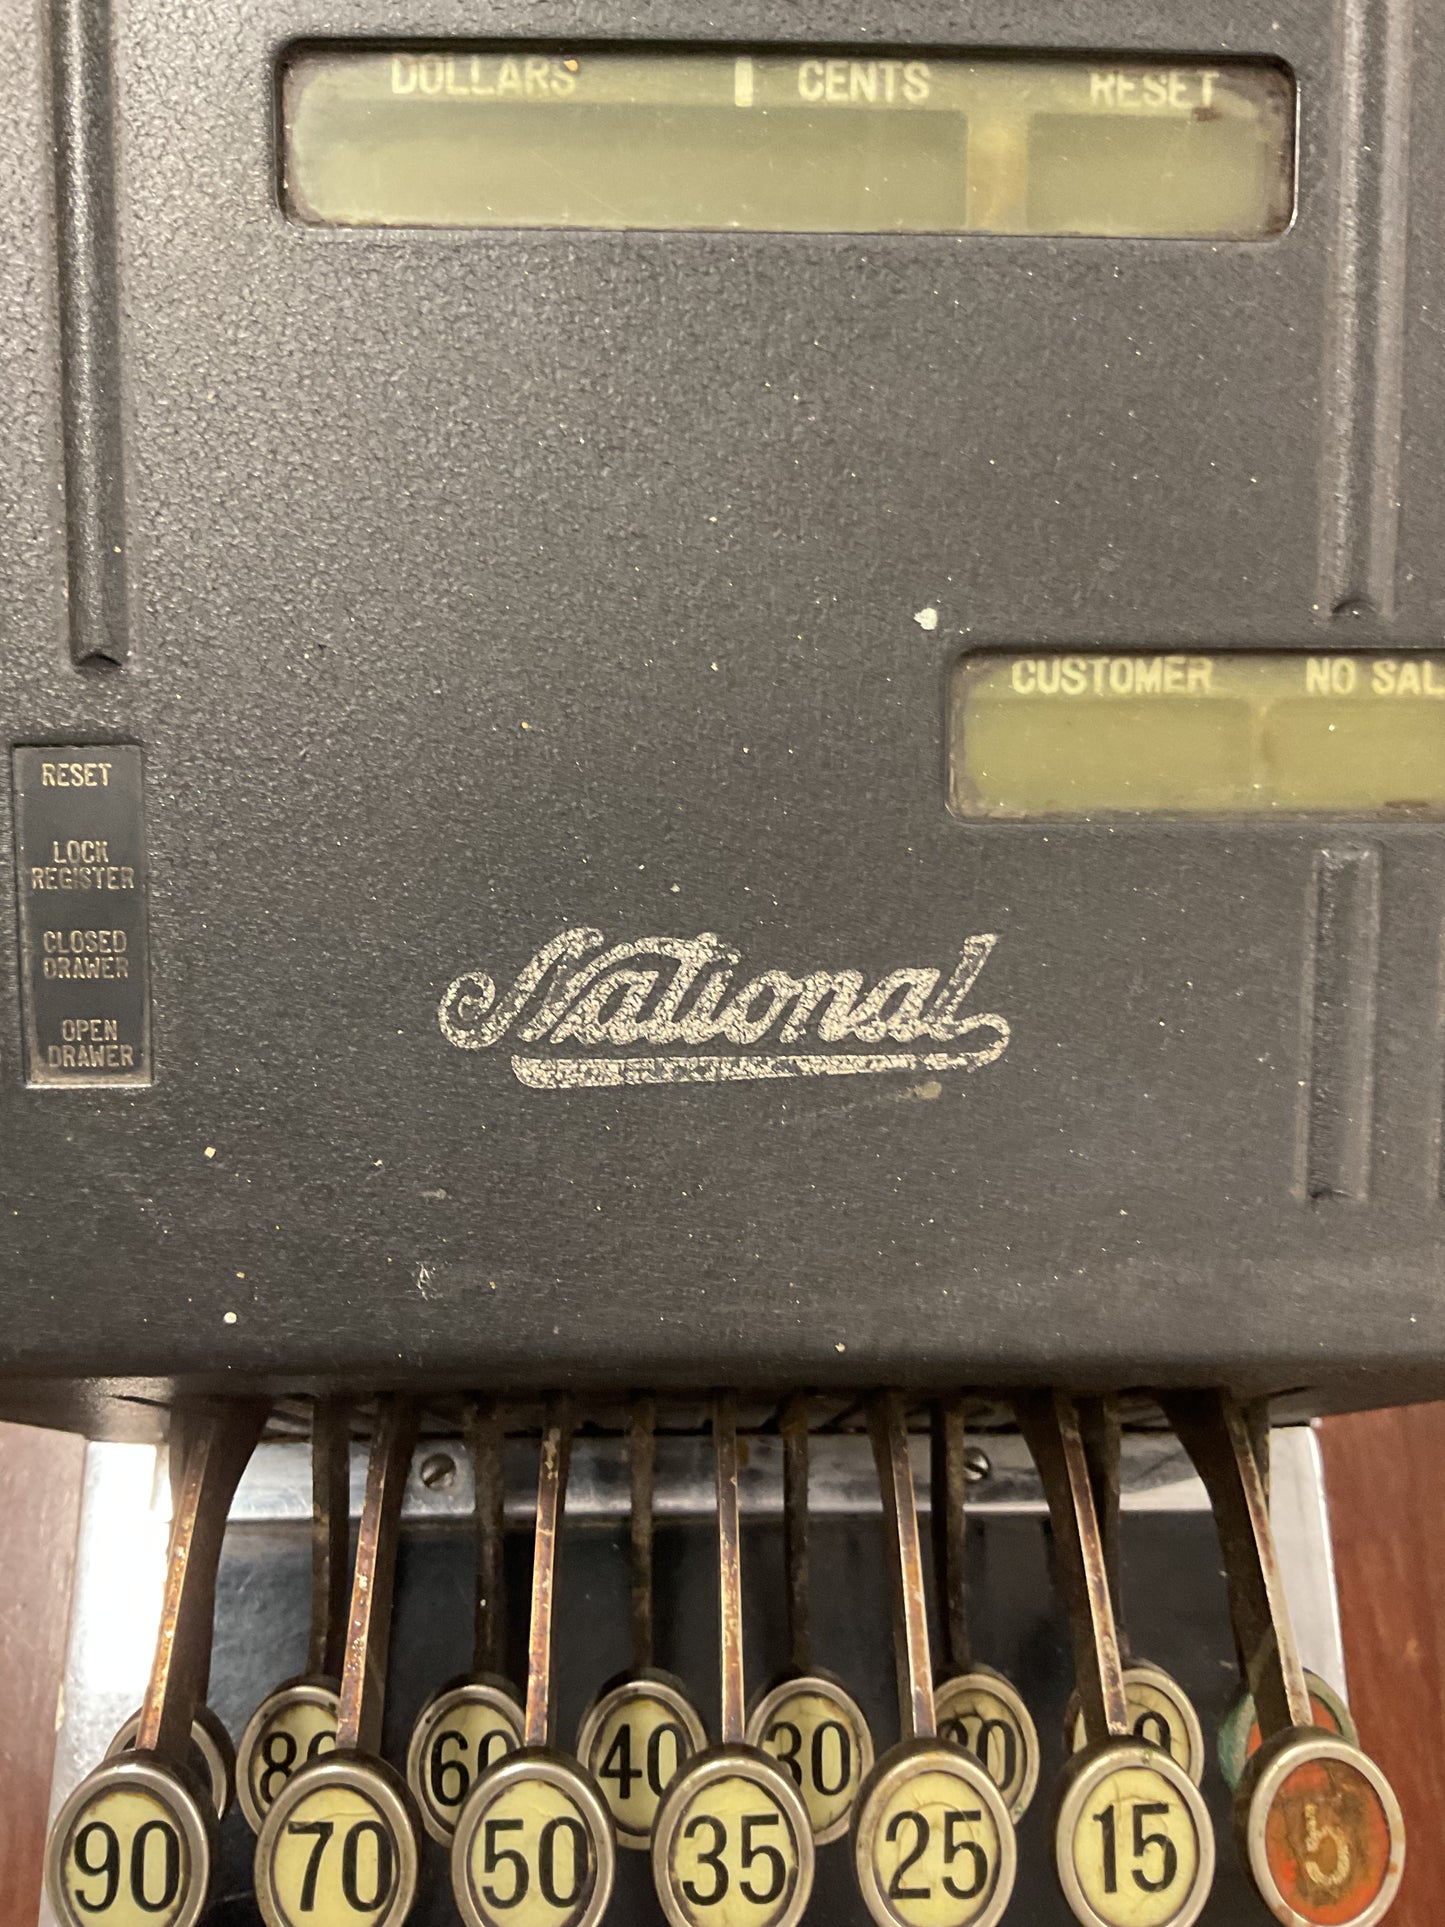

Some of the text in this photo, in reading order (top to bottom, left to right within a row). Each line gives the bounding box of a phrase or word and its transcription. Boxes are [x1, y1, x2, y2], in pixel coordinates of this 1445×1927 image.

[391, 56, 577, 96] DOLLARS
[798, 61, 931, 102] CENTS
[1090, 71, 1219, 108] RESET
[1011, 657, 1213, 695] CUSTOMER
[1306, 658, 1356, 695] NO
[41, 763, 112, 787] RESET
[53, 840, 109, 864] LOCK
[31, 867, 135, 889] REGISTER
[43, 930, 127, 953] CLOSED
[43, 956, 128, 979] DRAWER
[438, 927, 1011, 1090] National
[62, 1019, 117, 1042] OPEN
[48, 1044, 134, 1067] DRAWER
[481, 1816, 589, 1909] 50
[682, 1813, 786, 1906] 35
[885, 1809, 988, 1900] 25
[1092, 1802, 1178, 1894] 15
[1303, 1803, 1351, 1886] 5
[73, 1820, 181, 1914] 90
[287, 1820, 394, 1913] 70
